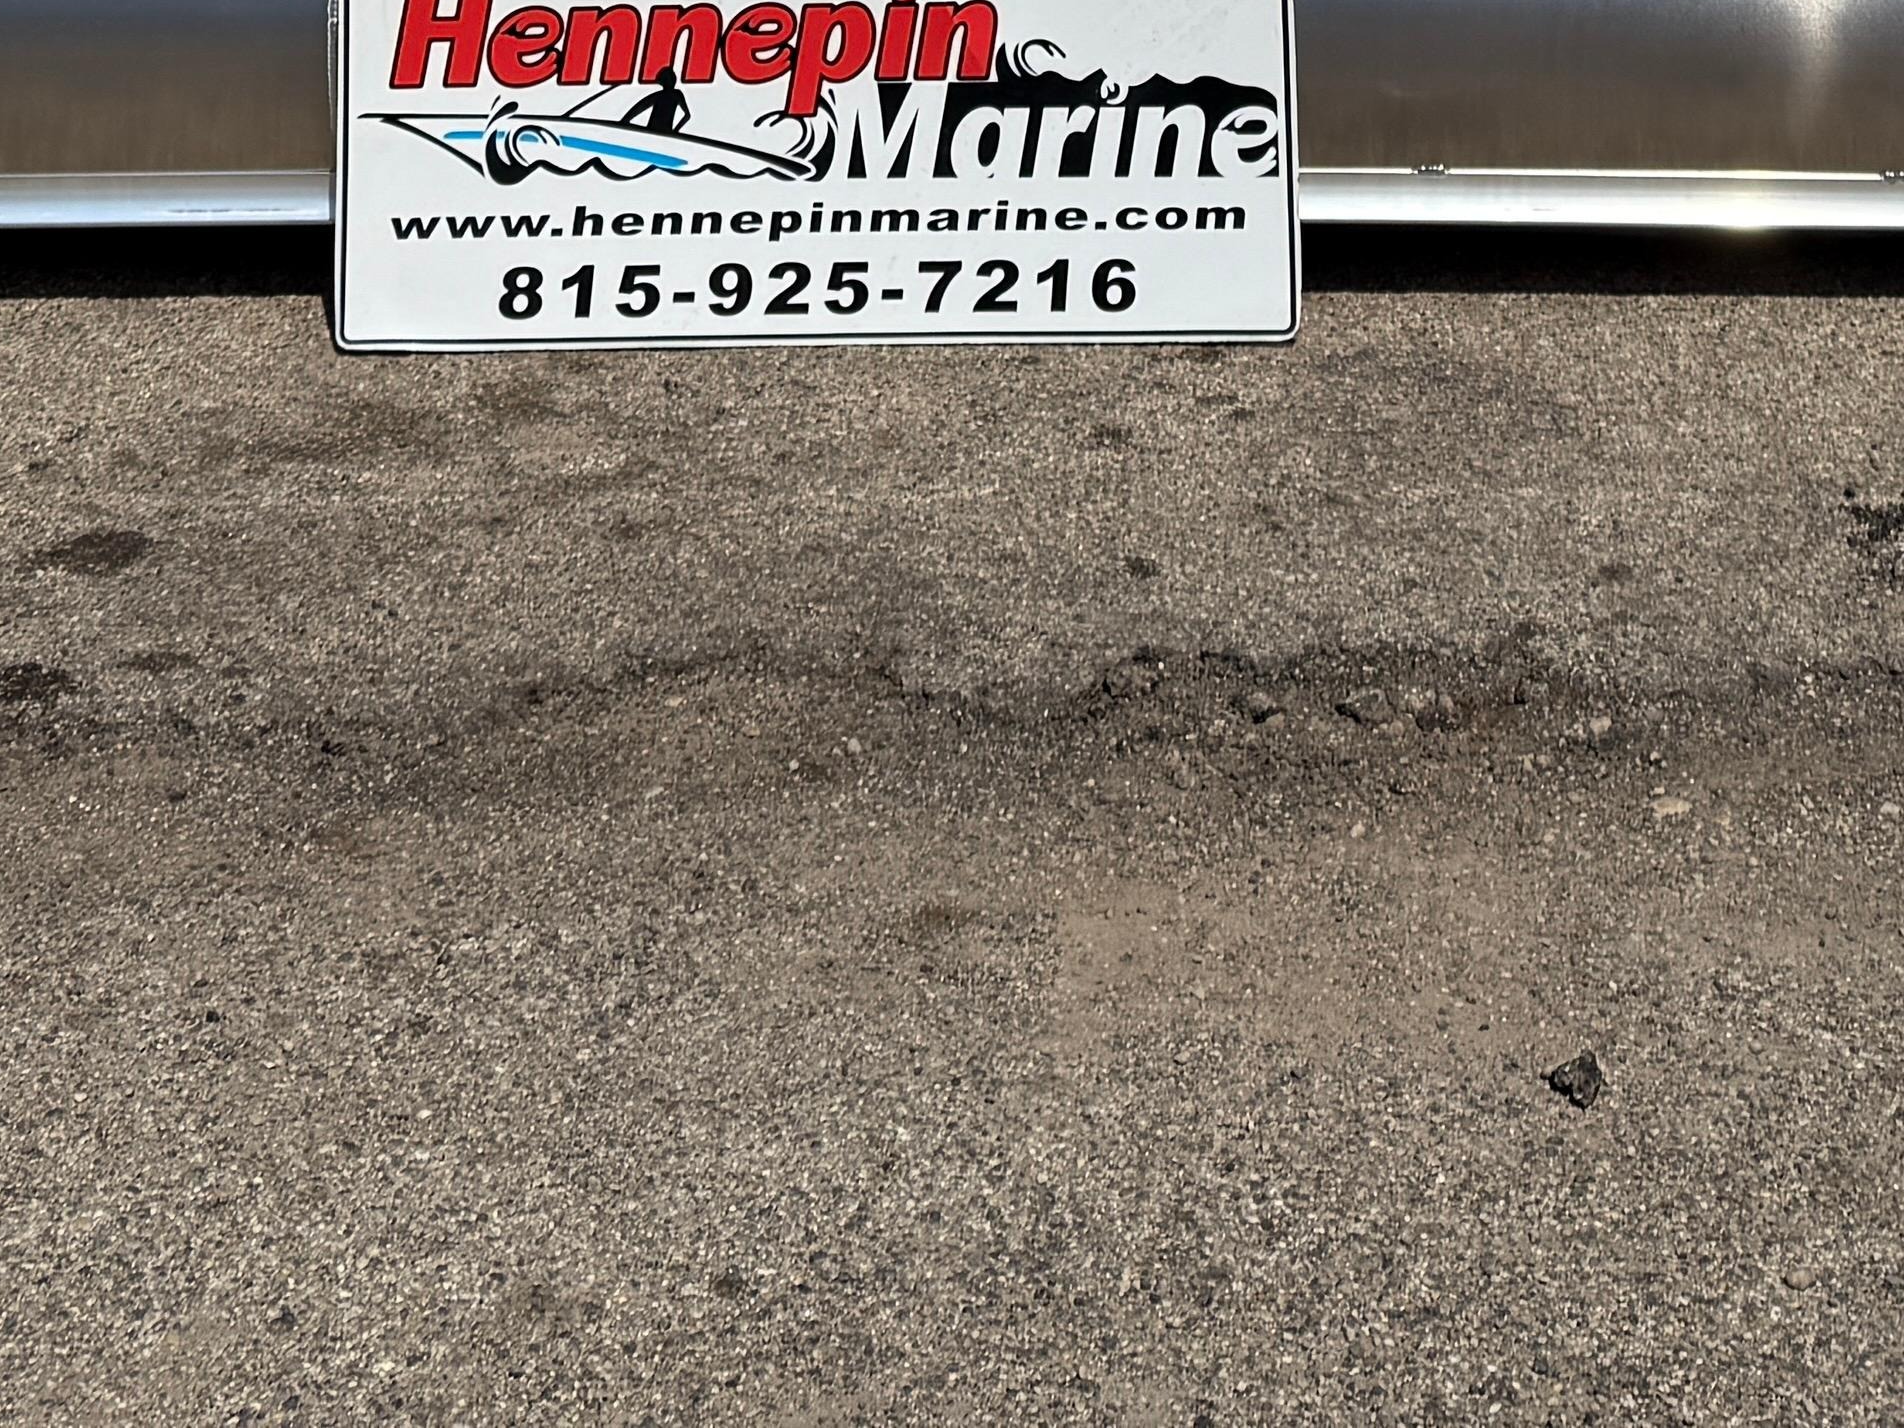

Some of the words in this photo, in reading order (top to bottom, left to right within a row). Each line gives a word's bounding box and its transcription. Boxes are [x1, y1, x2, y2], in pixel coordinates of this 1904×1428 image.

[836, 74, 1280, 180] Marine
[390, 199, 1248, 243] www.hennepinmarine.com
[497, 257, 1138, 321] 815-925-7216
